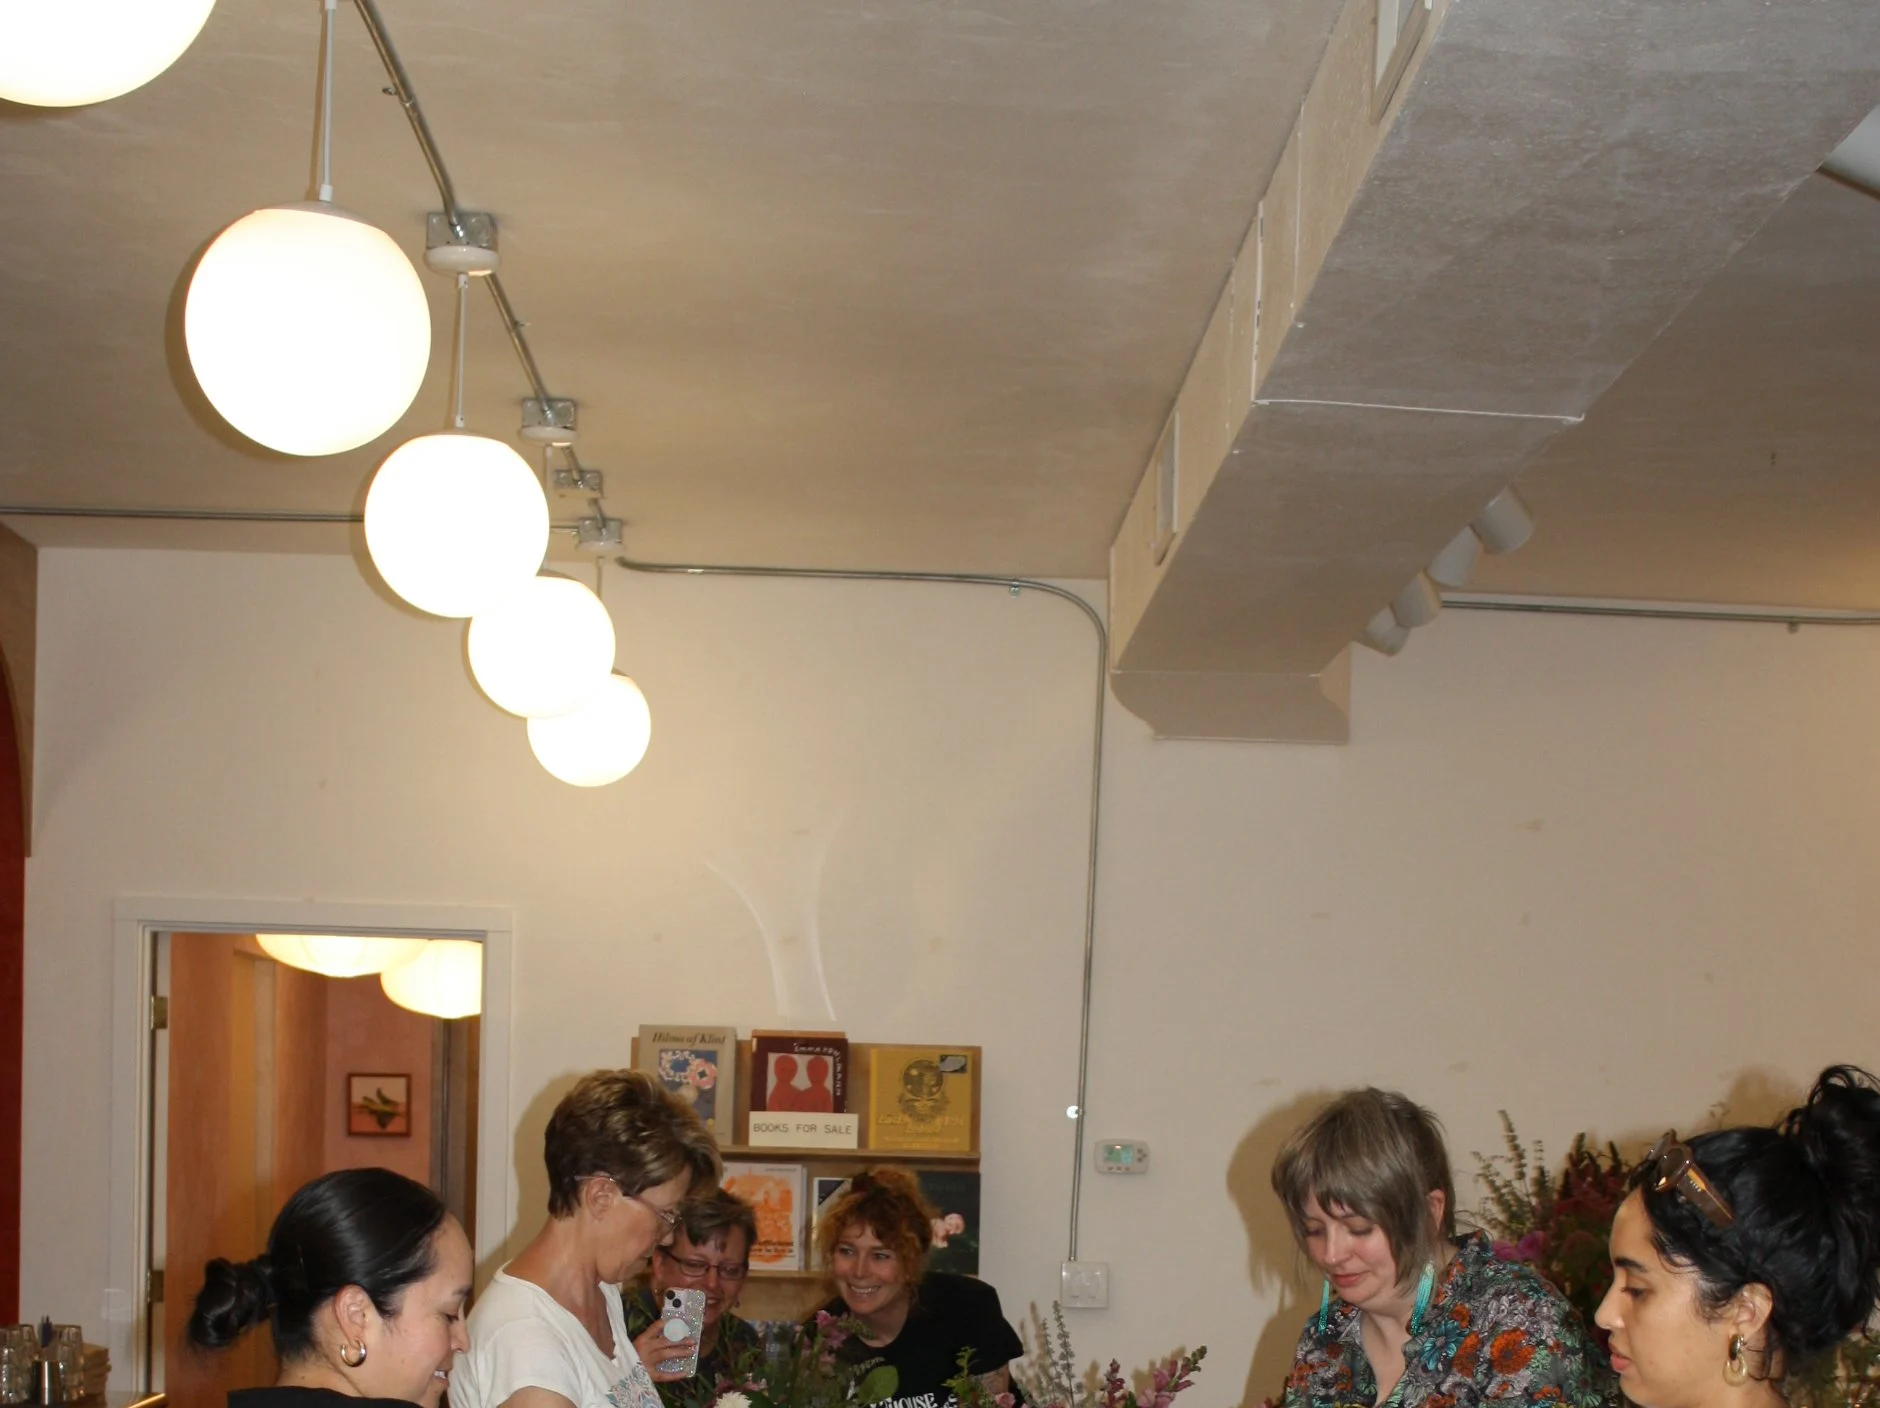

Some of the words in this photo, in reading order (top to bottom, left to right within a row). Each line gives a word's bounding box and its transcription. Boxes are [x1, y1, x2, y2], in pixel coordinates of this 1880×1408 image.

[652, 1031, 684, 1043] Hilma
[699, 1033, 727, 1045] Klint
[753, 1122, 789, 1134] BOOKS
[796, 1123, 817, 1134] FOR
[824, 1124, 852, 1135] SALE
